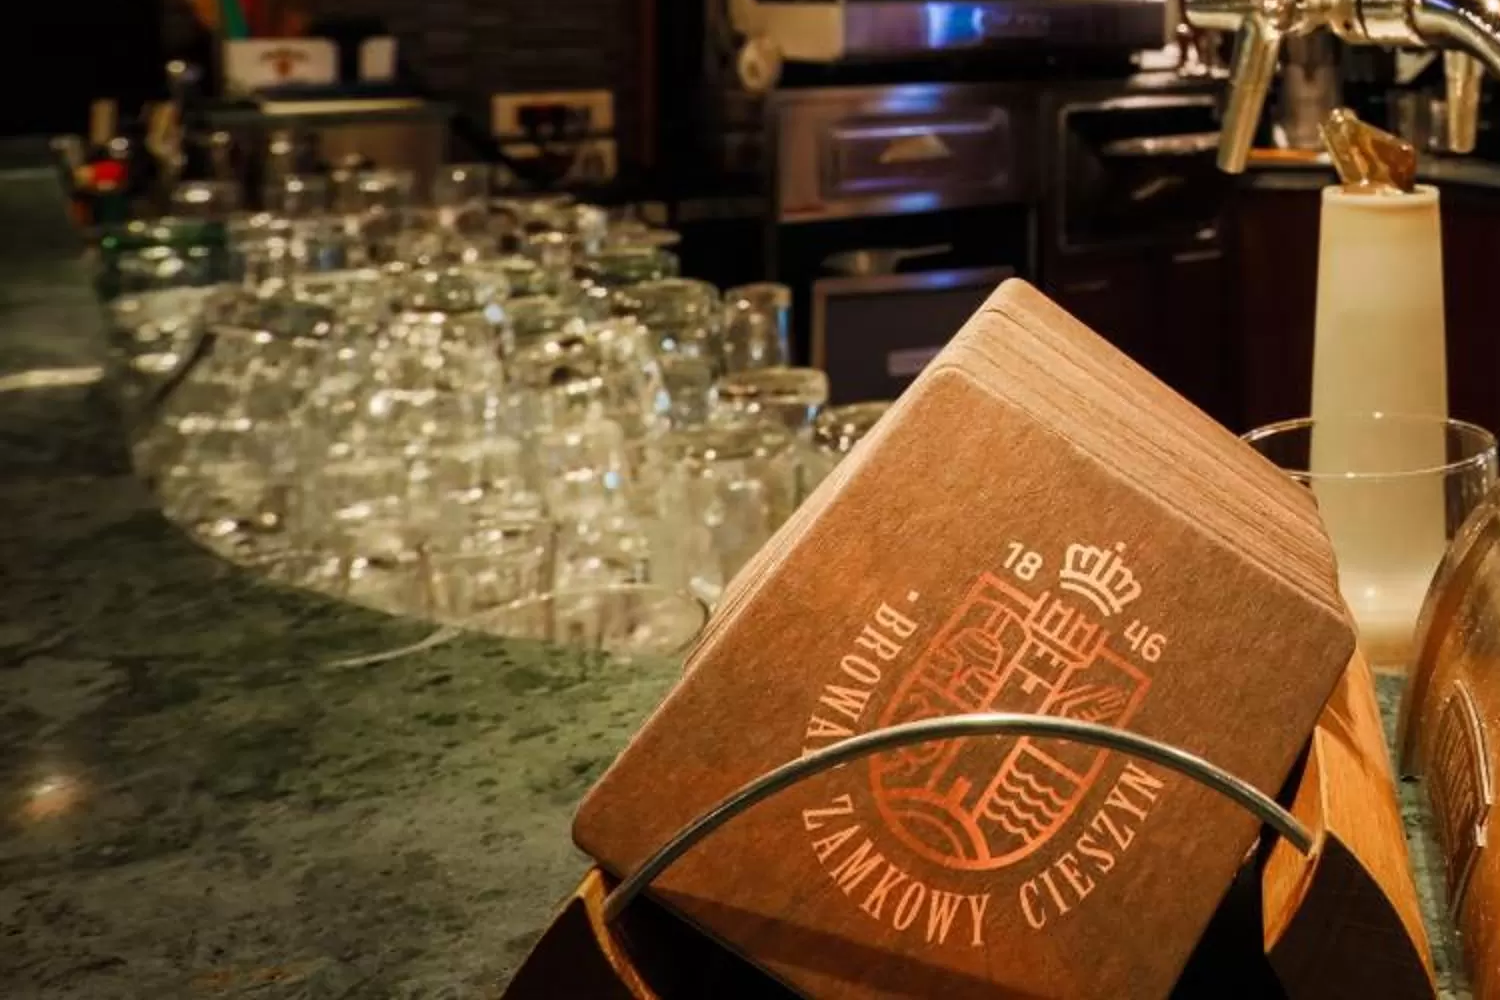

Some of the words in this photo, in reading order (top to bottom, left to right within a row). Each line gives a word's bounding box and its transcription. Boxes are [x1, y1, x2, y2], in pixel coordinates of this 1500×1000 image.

[1001, 541, 1044, 581] 18
[1123, 618, 1168, 663] 46
[802, 602, 919, 769] BROWA
[802, 794, 990, 946] ZAMKOWY
[1018, 761, 1165, 930] CIESZYN
